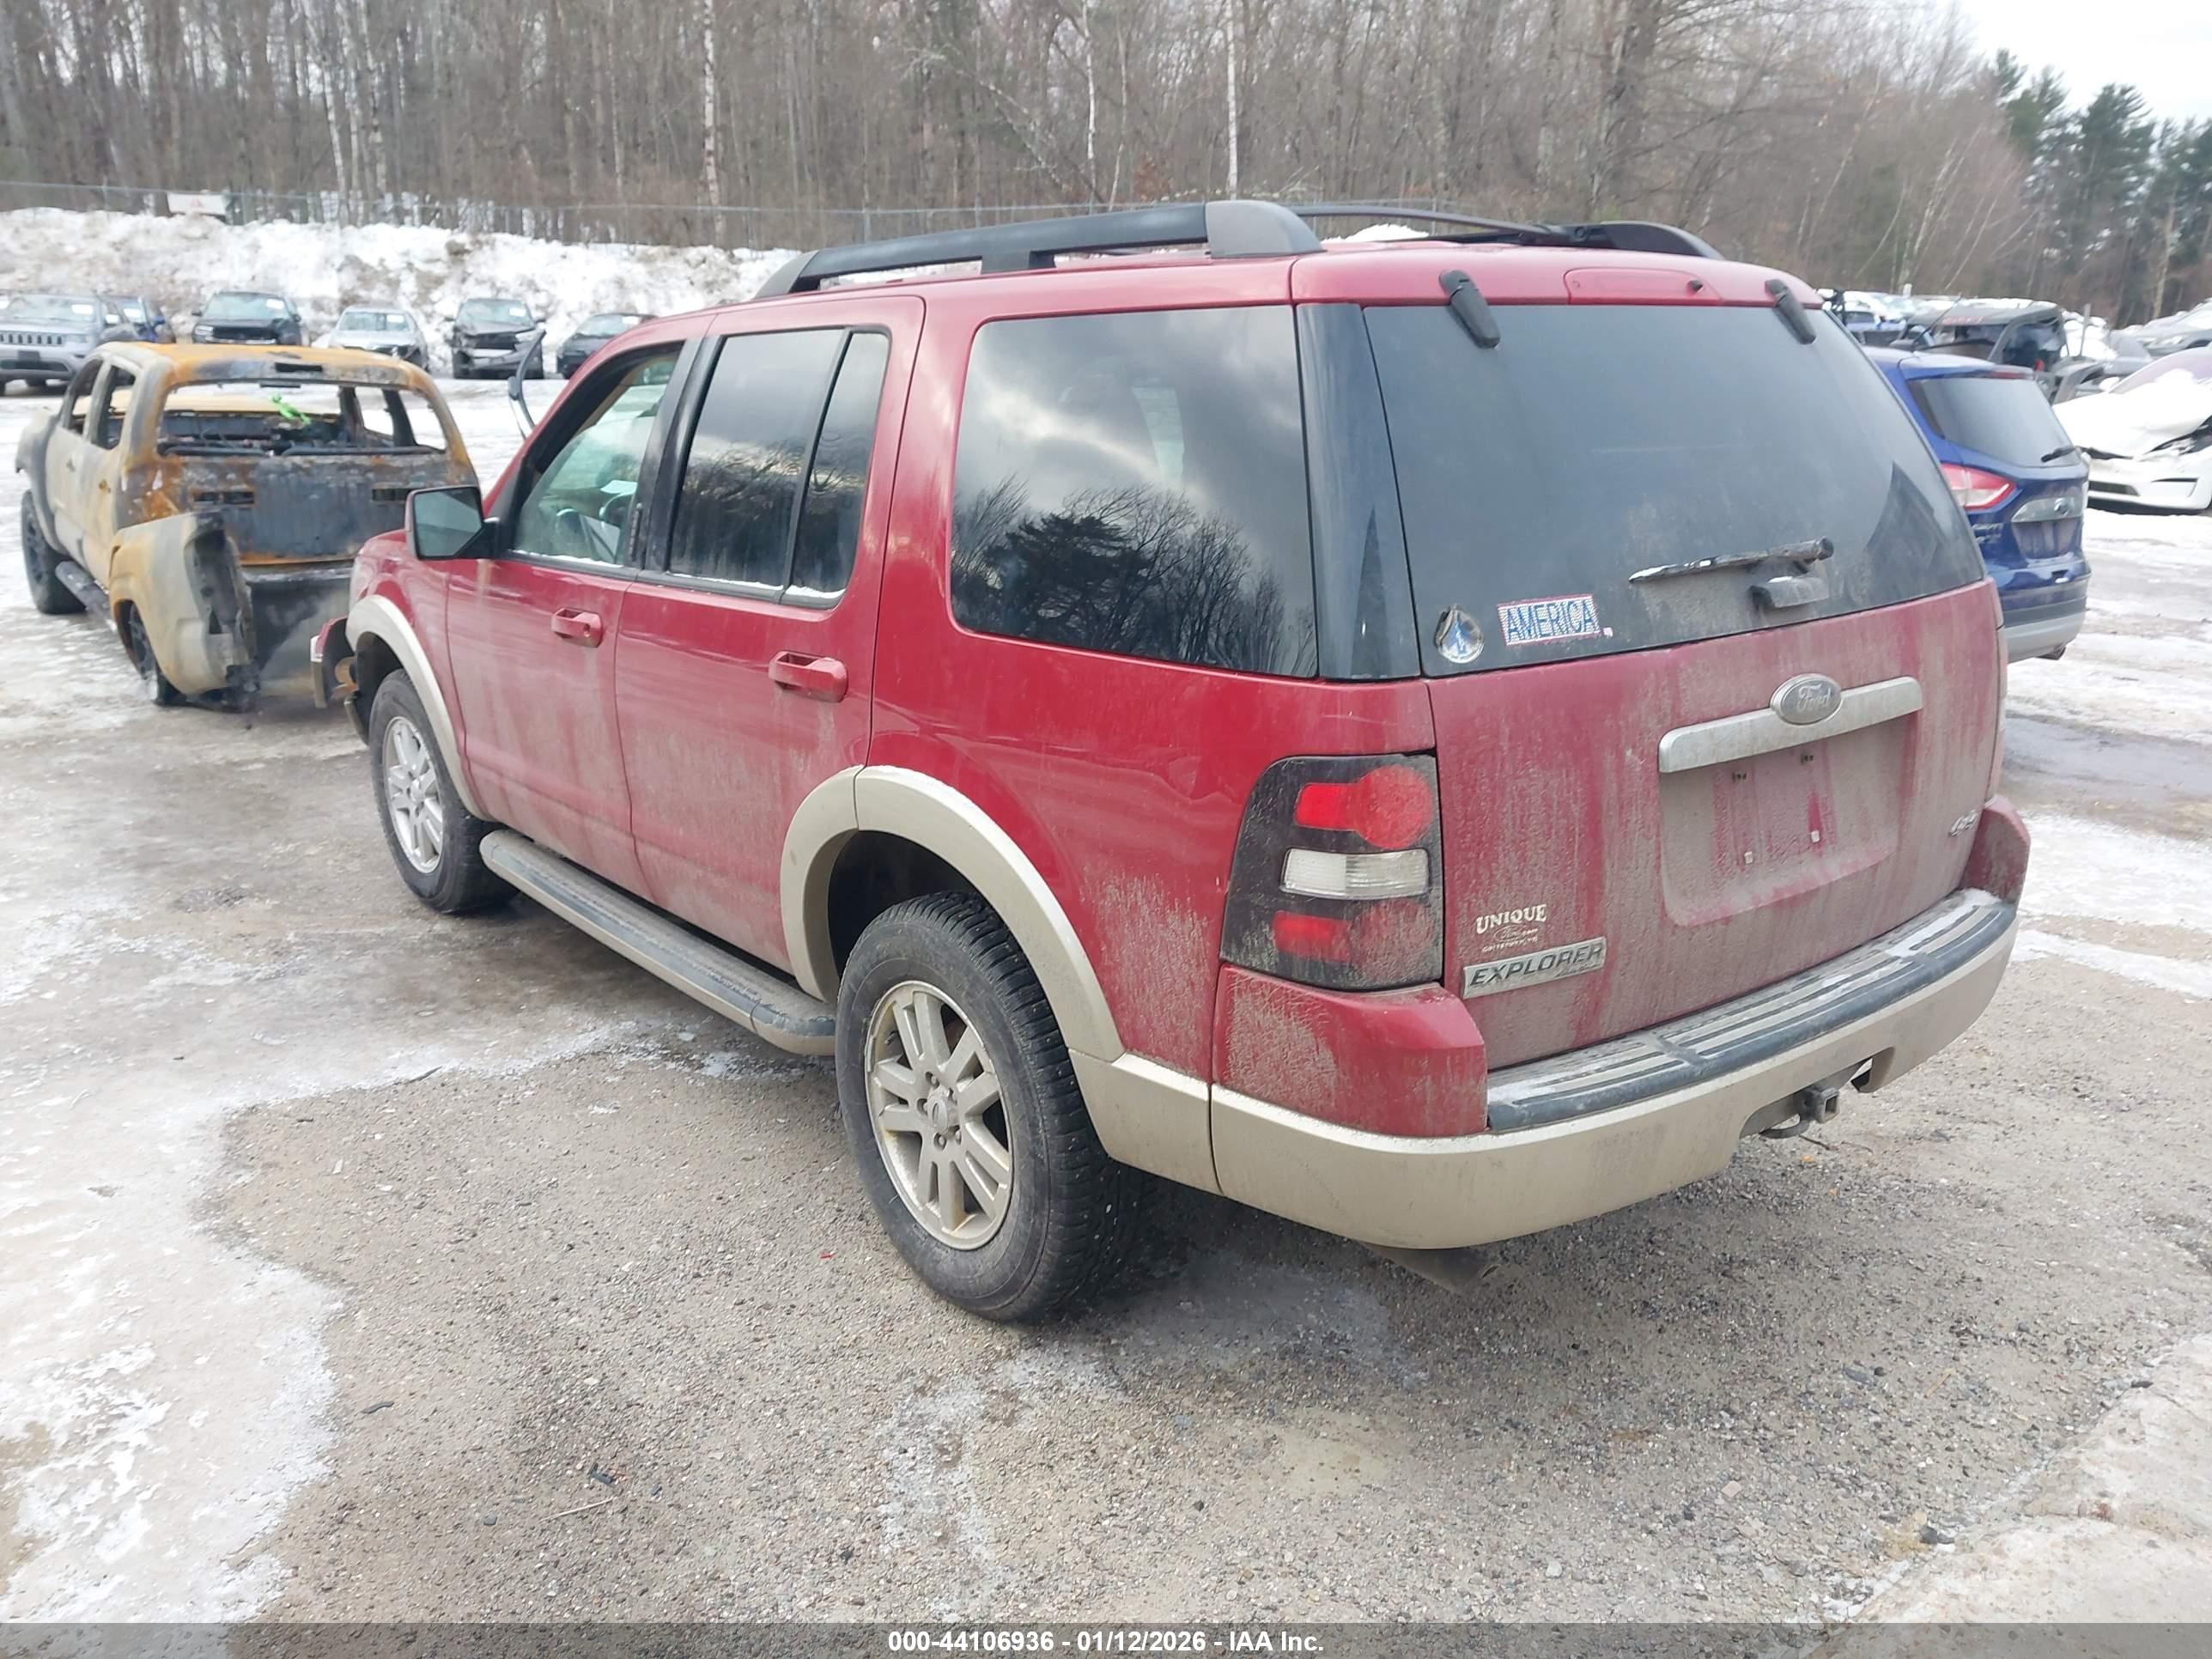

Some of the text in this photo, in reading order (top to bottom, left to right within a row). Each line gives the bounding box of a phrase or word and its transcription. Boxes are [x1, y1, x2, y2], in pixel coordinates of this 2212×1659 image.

[1505, 598, 1596, 641] AMERICA
[1797, 684, 1831, 712] Ford
[1476, 904, 1547, 933] UNIQUE
[1470, 943, 1603, 986] EXPLORER
